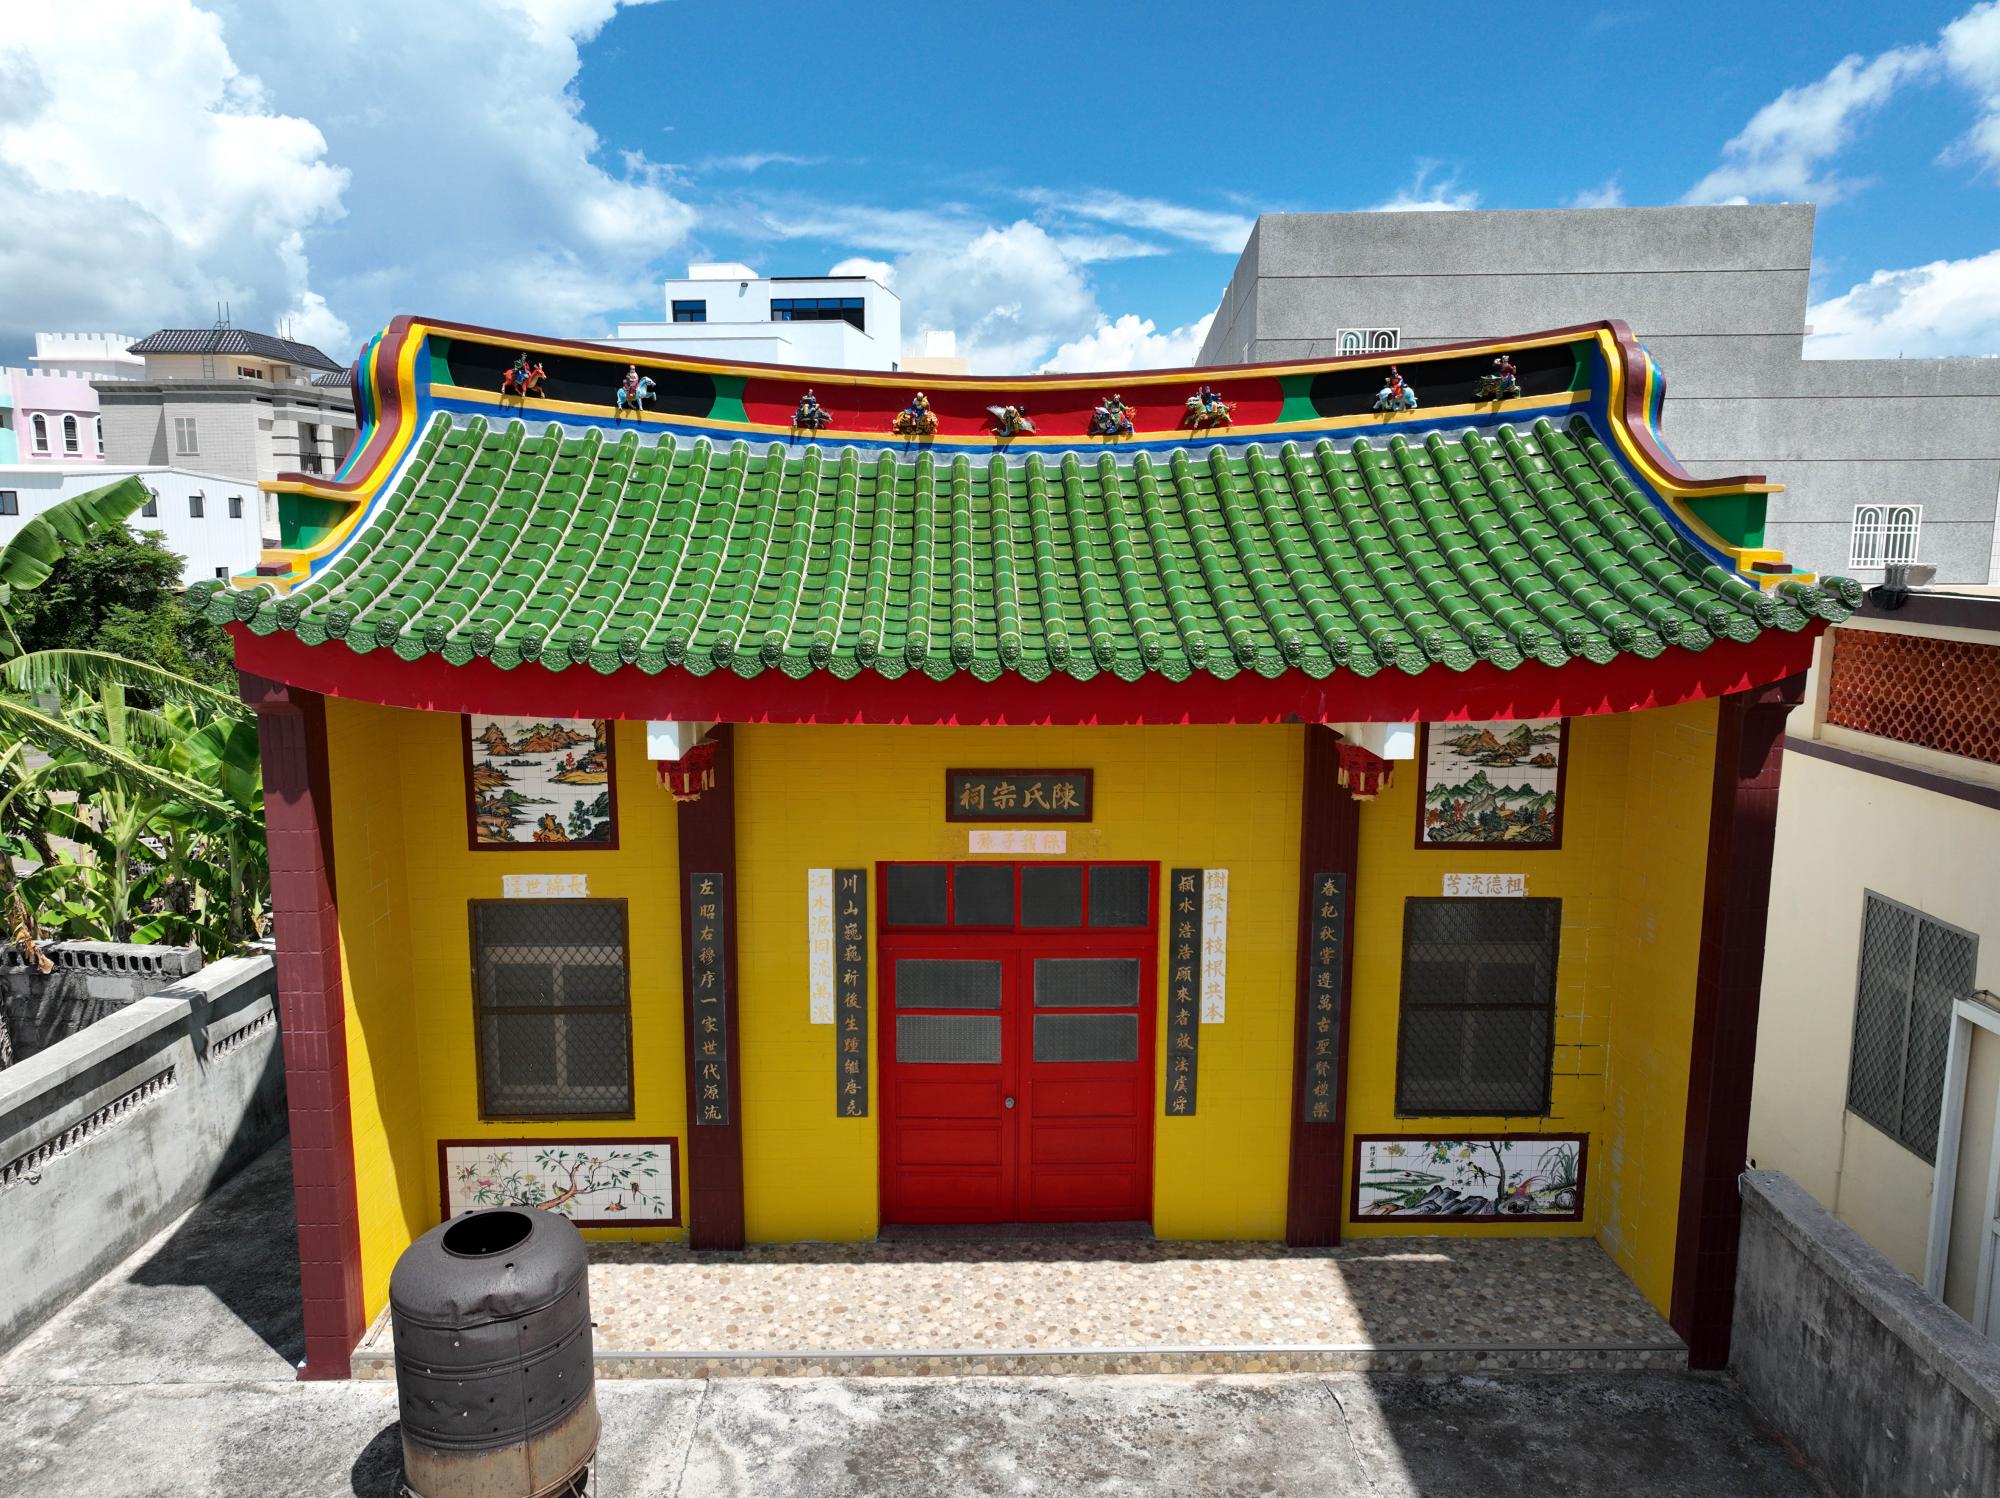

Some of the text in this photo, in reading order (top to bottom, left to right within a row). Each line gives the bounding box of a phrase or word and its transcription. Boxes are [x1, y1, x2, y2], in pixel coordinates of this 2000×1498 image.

[960, 781, 1080, 811] 陳氏宗祠
[1447, 875, 1523, 896] 祖德流芳
[1205, 871, 1227, 1022] 樹發千枝根共本
[698, 878, 722, 1121] 左昭右穆序一家世代源流
